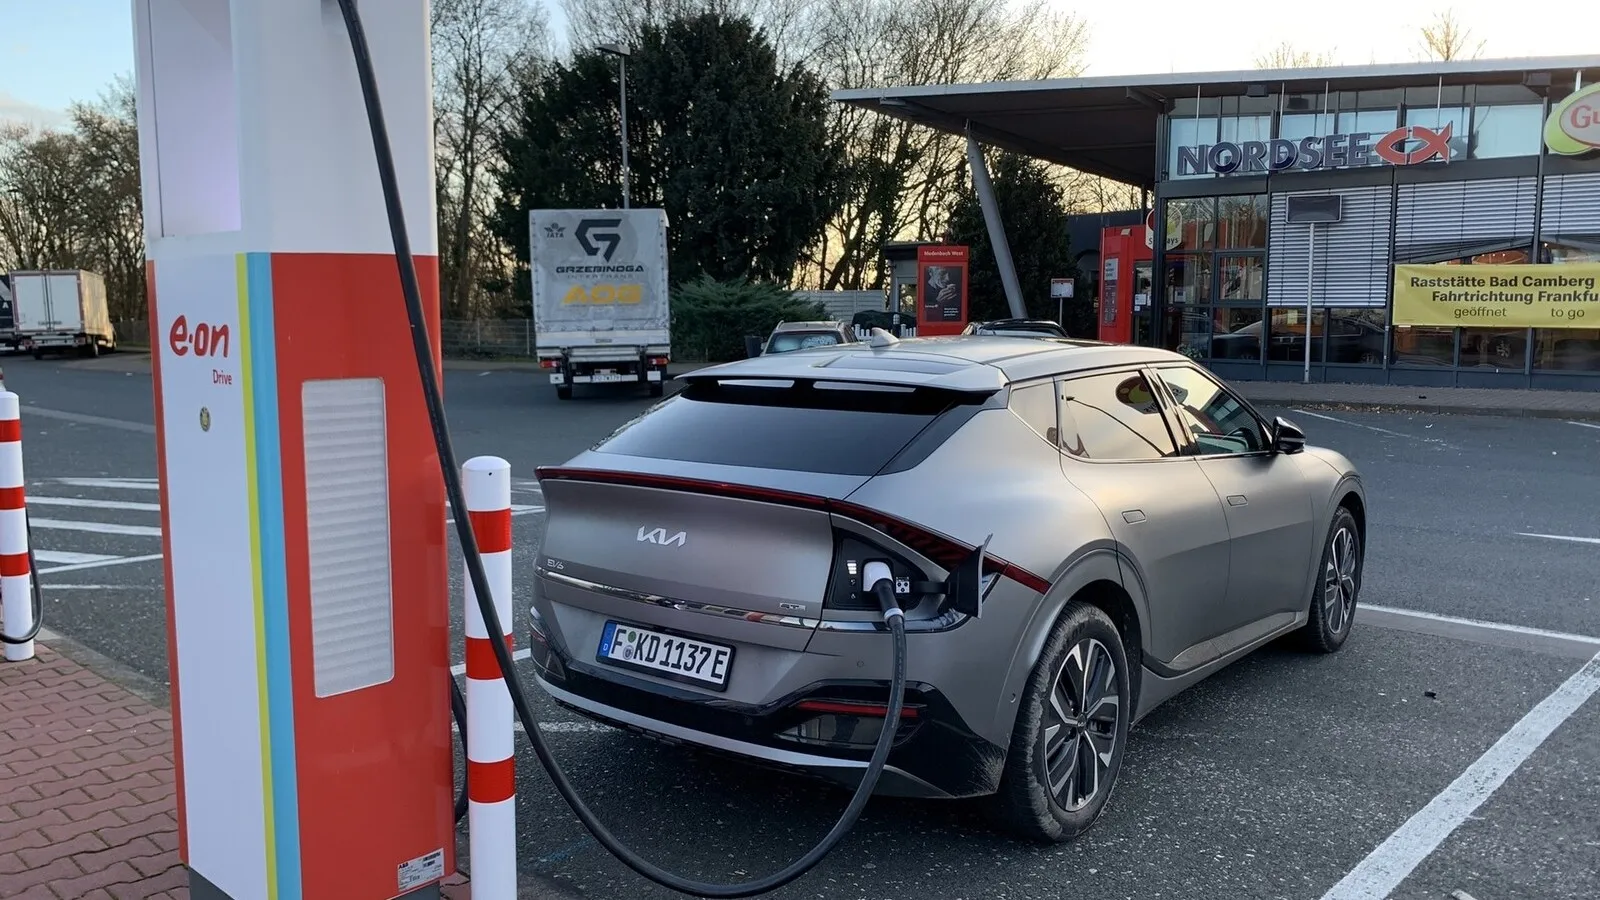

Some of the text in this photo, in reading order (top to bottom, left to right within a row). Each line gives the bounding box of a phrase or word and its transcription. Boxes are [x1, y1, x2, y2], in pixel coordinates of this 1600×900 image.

[1177, 132, 1370, 176] NORDSEE
[1410, 275, 1595, 290] Raststätte Bad Camberg
[1432, 290, 1533, 305] Fahrtrichtung
[1454, 306, 1585, 320] geöffnet to go
[212, 369, 233, 385] Drive
[636, 525, 687, 547] KIA
[547, 558, 564, 570] EV6
